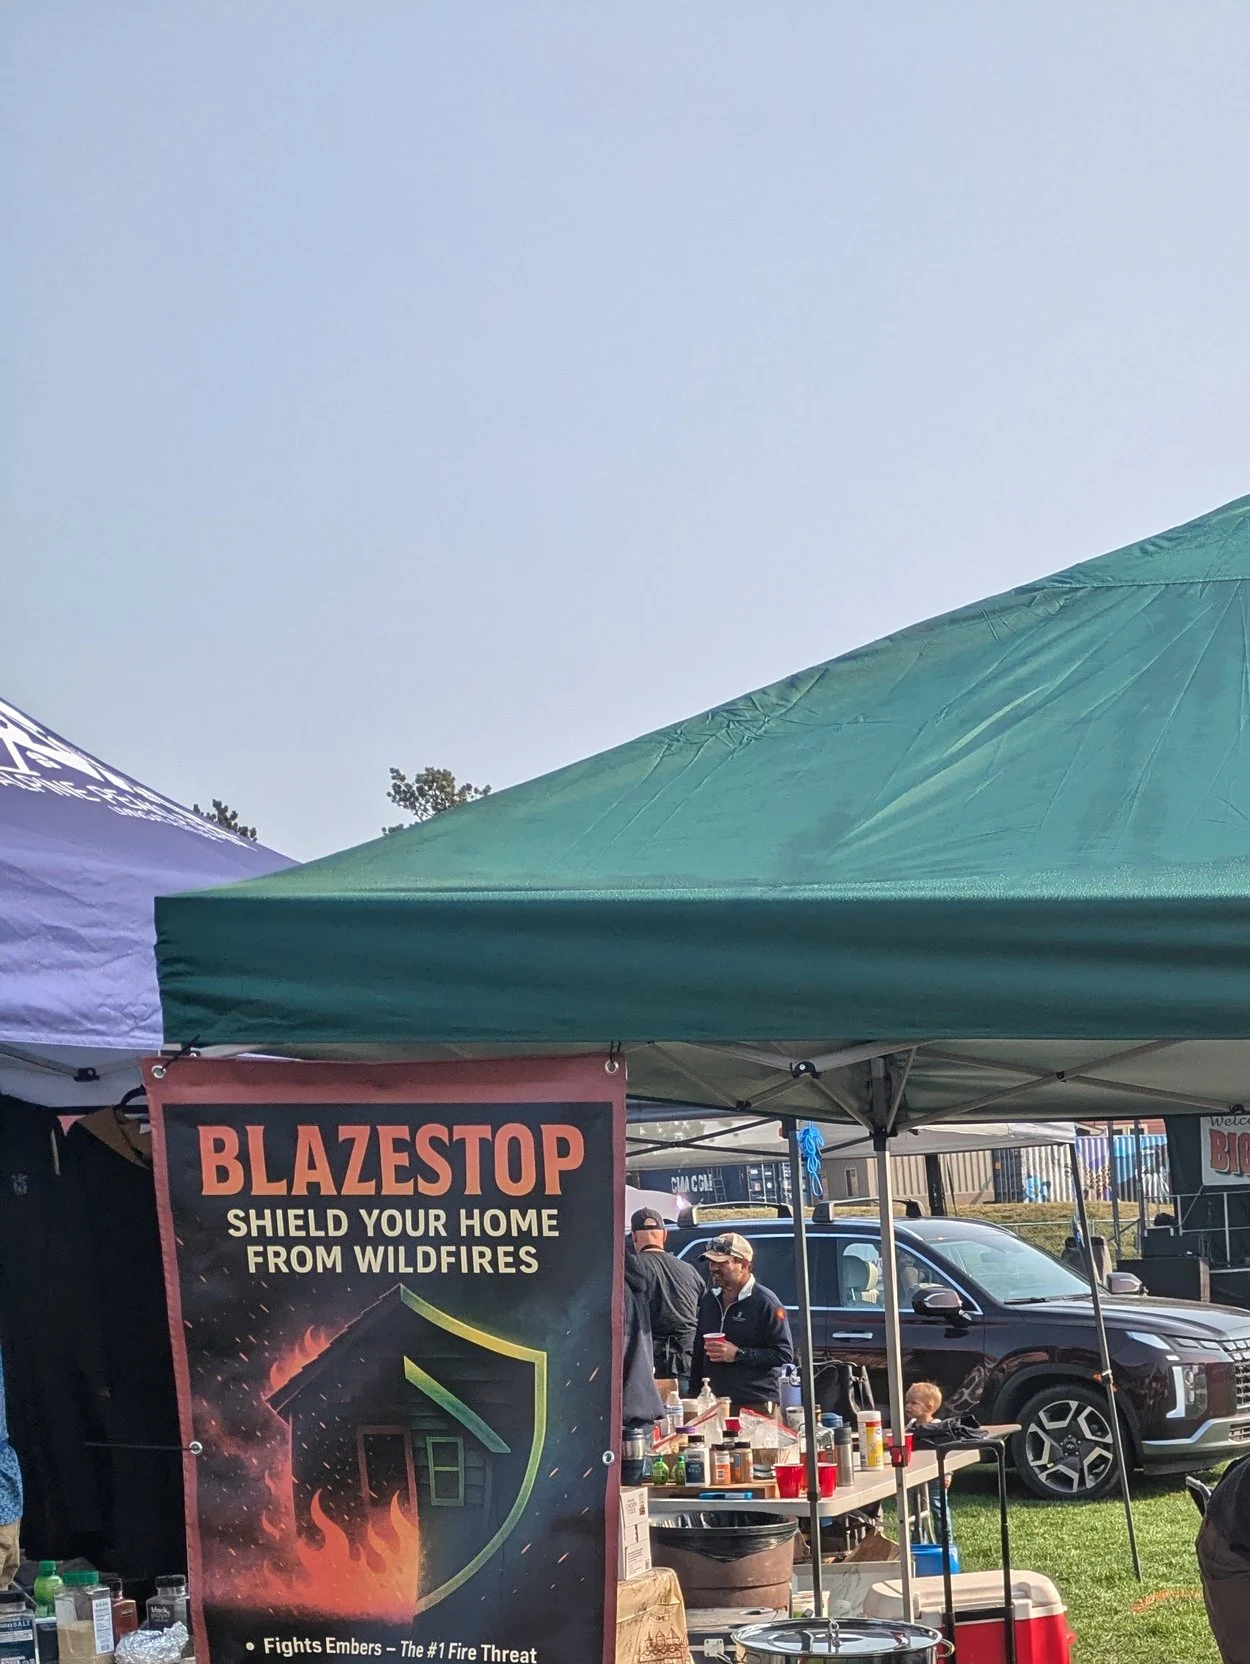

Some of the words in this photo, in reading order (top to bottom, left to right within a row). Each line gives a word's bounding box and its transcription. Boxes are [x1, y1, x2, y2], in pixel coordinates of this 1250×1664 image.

[197, 1122, 585, 1196] BLAZESTOP
[227, 1208, 349, 1238] SHIELD
[358, 1208, 448, 1238] YOUR
[459, 1208, 560, 1238] HOME
[247, 1246, 342, 1275] FROM
[354, 1245, 539, 1274] WILDFIRES
[263, 1637, 322, 1658] Fights
[325, 1637, 382, 1656] Embers
[400, 1640, 424, 1659] The
[426, 1642, 445, 1660] #1
[448, 1643, 477, 1661] Fire
[481, 1644, 537, 1664] Threat
